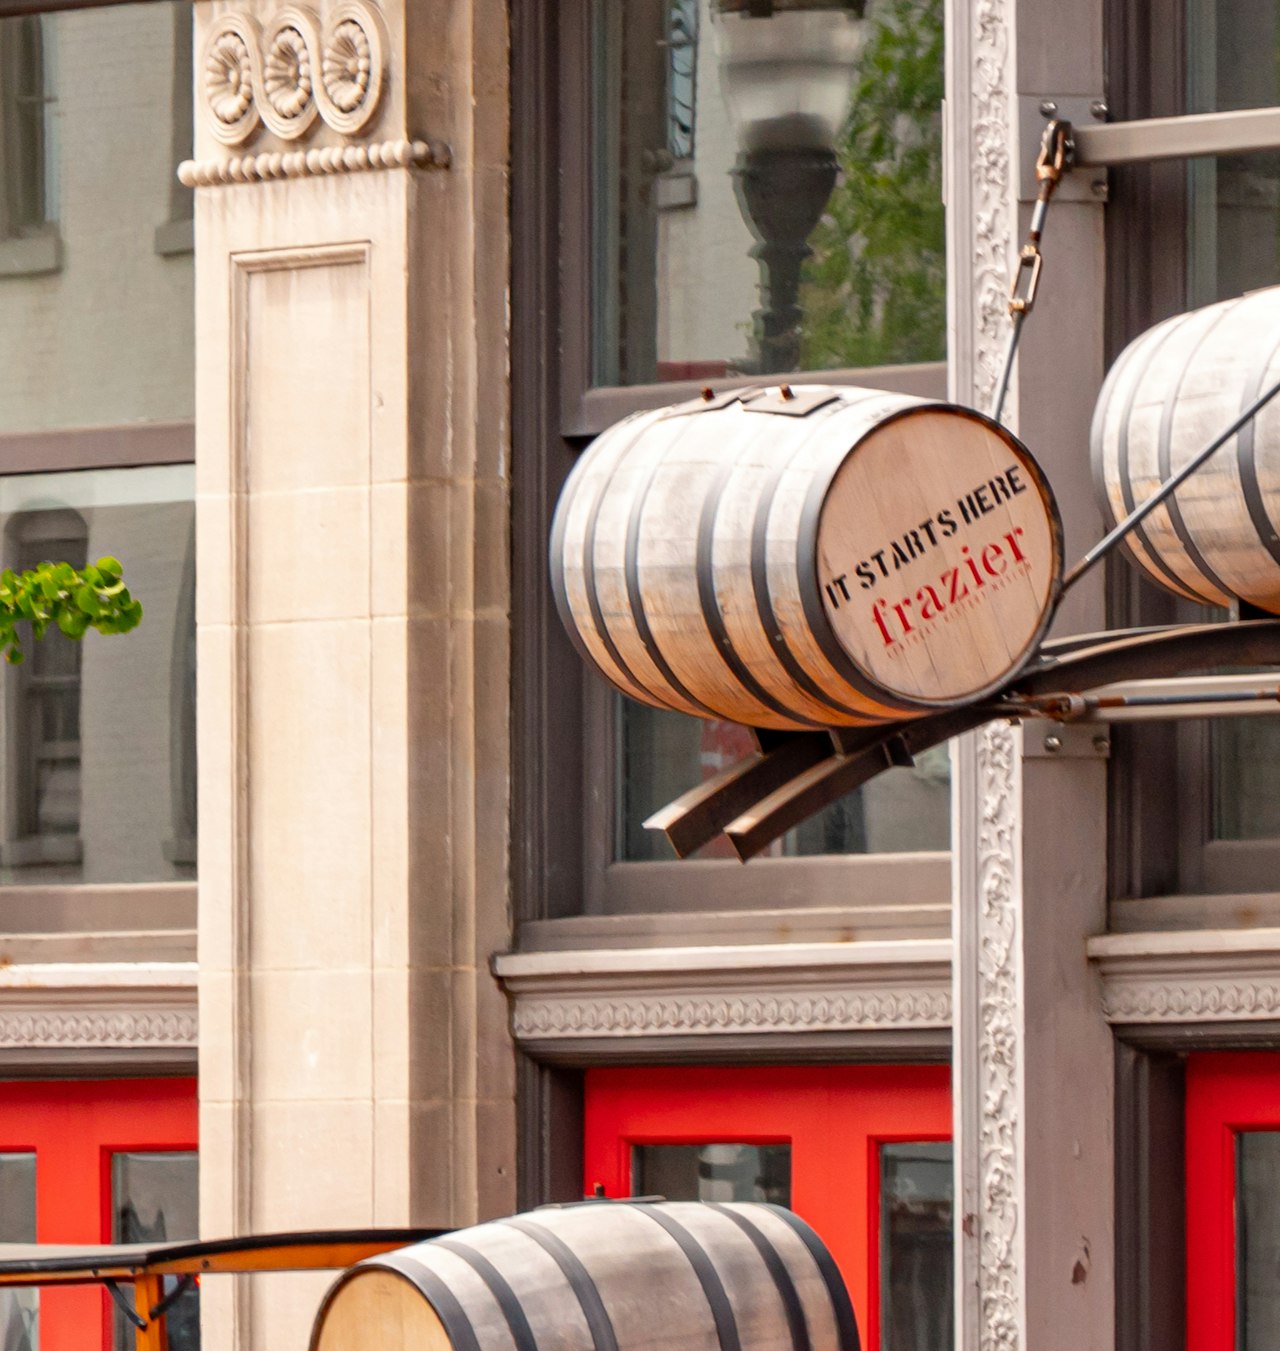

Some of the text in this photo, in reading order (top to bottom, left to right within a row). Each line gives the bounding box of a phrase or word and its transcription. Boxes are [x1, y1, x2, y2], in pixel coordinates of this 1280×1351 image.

[825, 574, 852, 610] IT
[855, 509, 958, 590] STARTS
[957, 464, 1027, 525] HERE
[872, 526, 1025, 647] frazier
